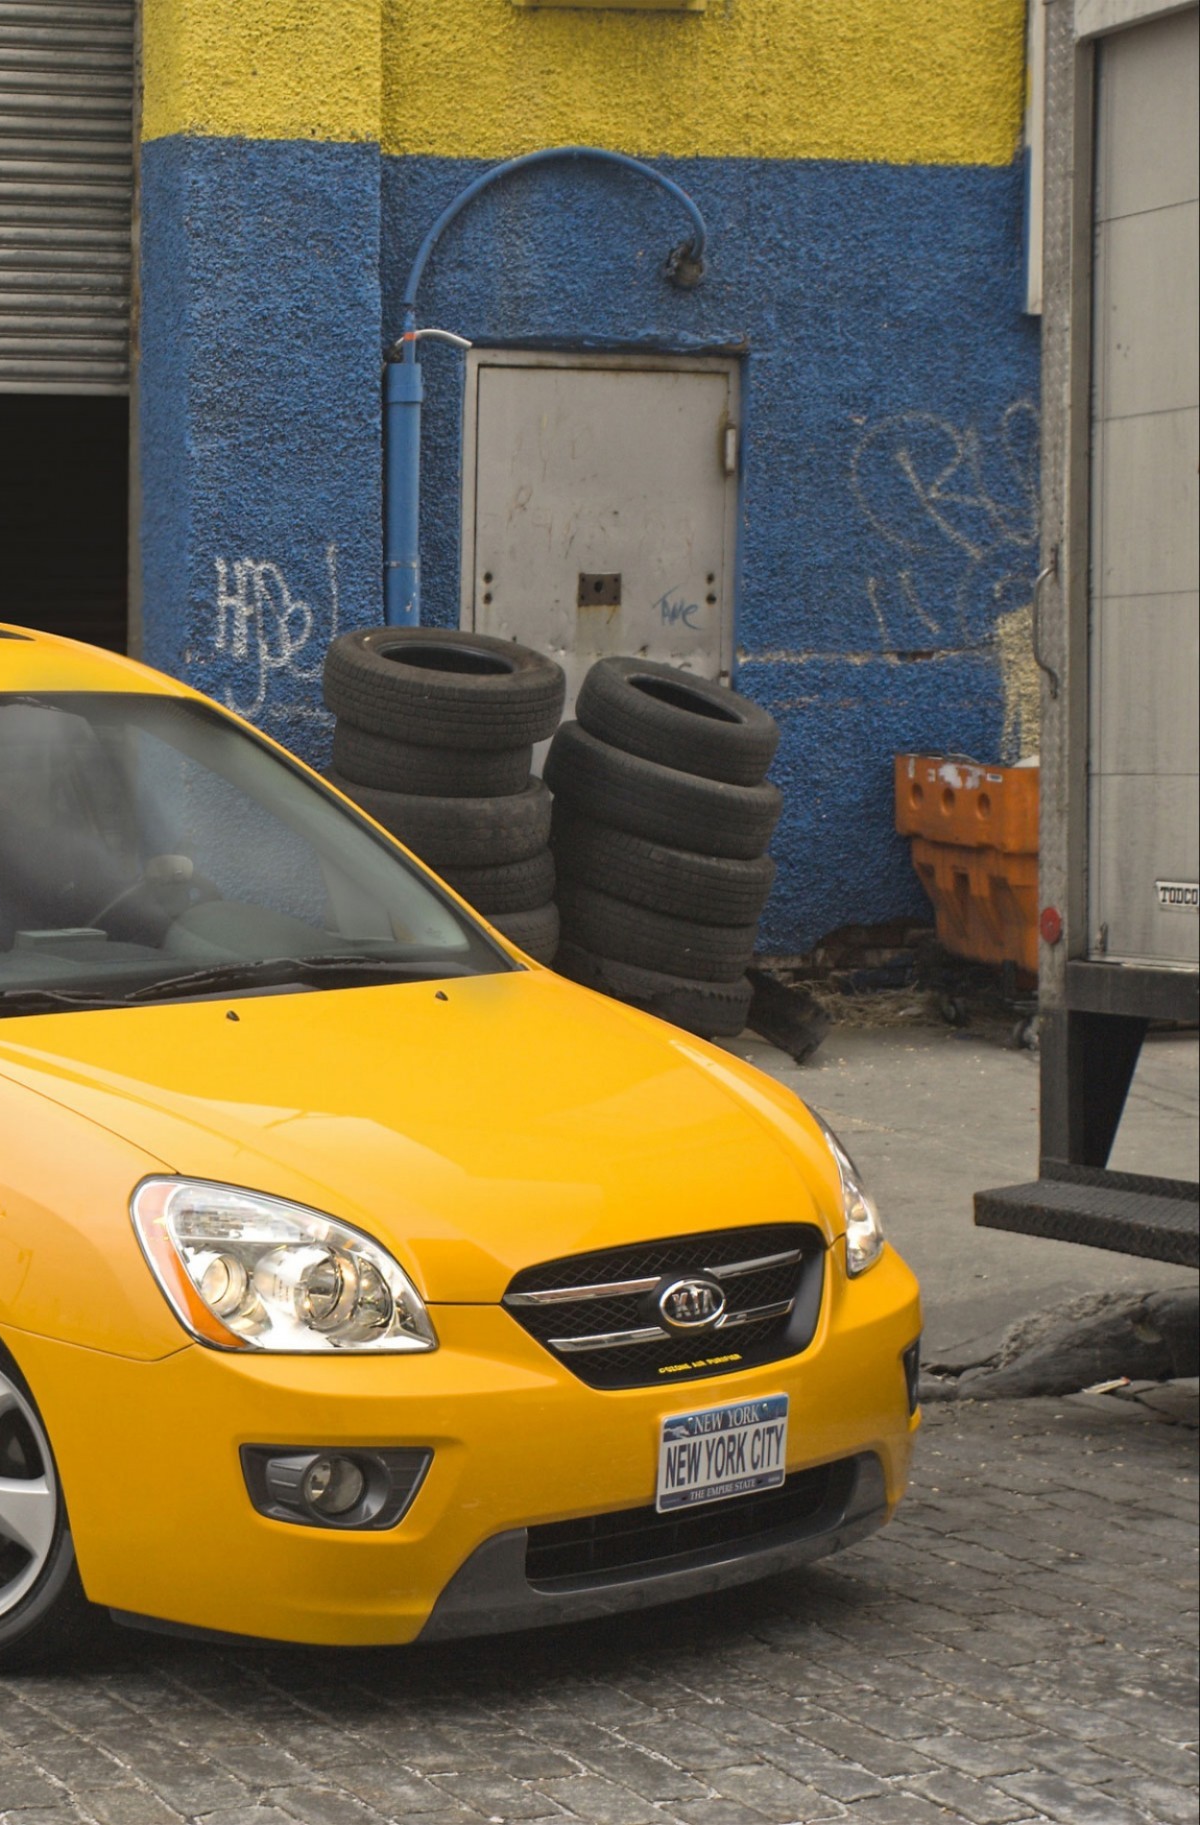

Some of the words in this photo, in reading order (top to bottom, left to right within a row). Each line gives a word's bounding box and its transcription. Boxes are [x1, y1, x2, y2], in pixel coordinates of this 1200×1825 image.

[1160, 886, 1198, 905] TODCO
[671, 1286, 716, 1319] KIA
[694, 1411, 725, 1435] NEW
[728, 1404, 760, 1428] YORK
[665, 1440, 702, 1489] NEW
[705, 1431, 747, 1481] YORK
[751, 1424, 785, 1471] CITY
[690, 1488, 705, 1501] THE
[706, 1482, 734, 1497] EMPIRE
[735, 1478, 757, 1491] STATE
